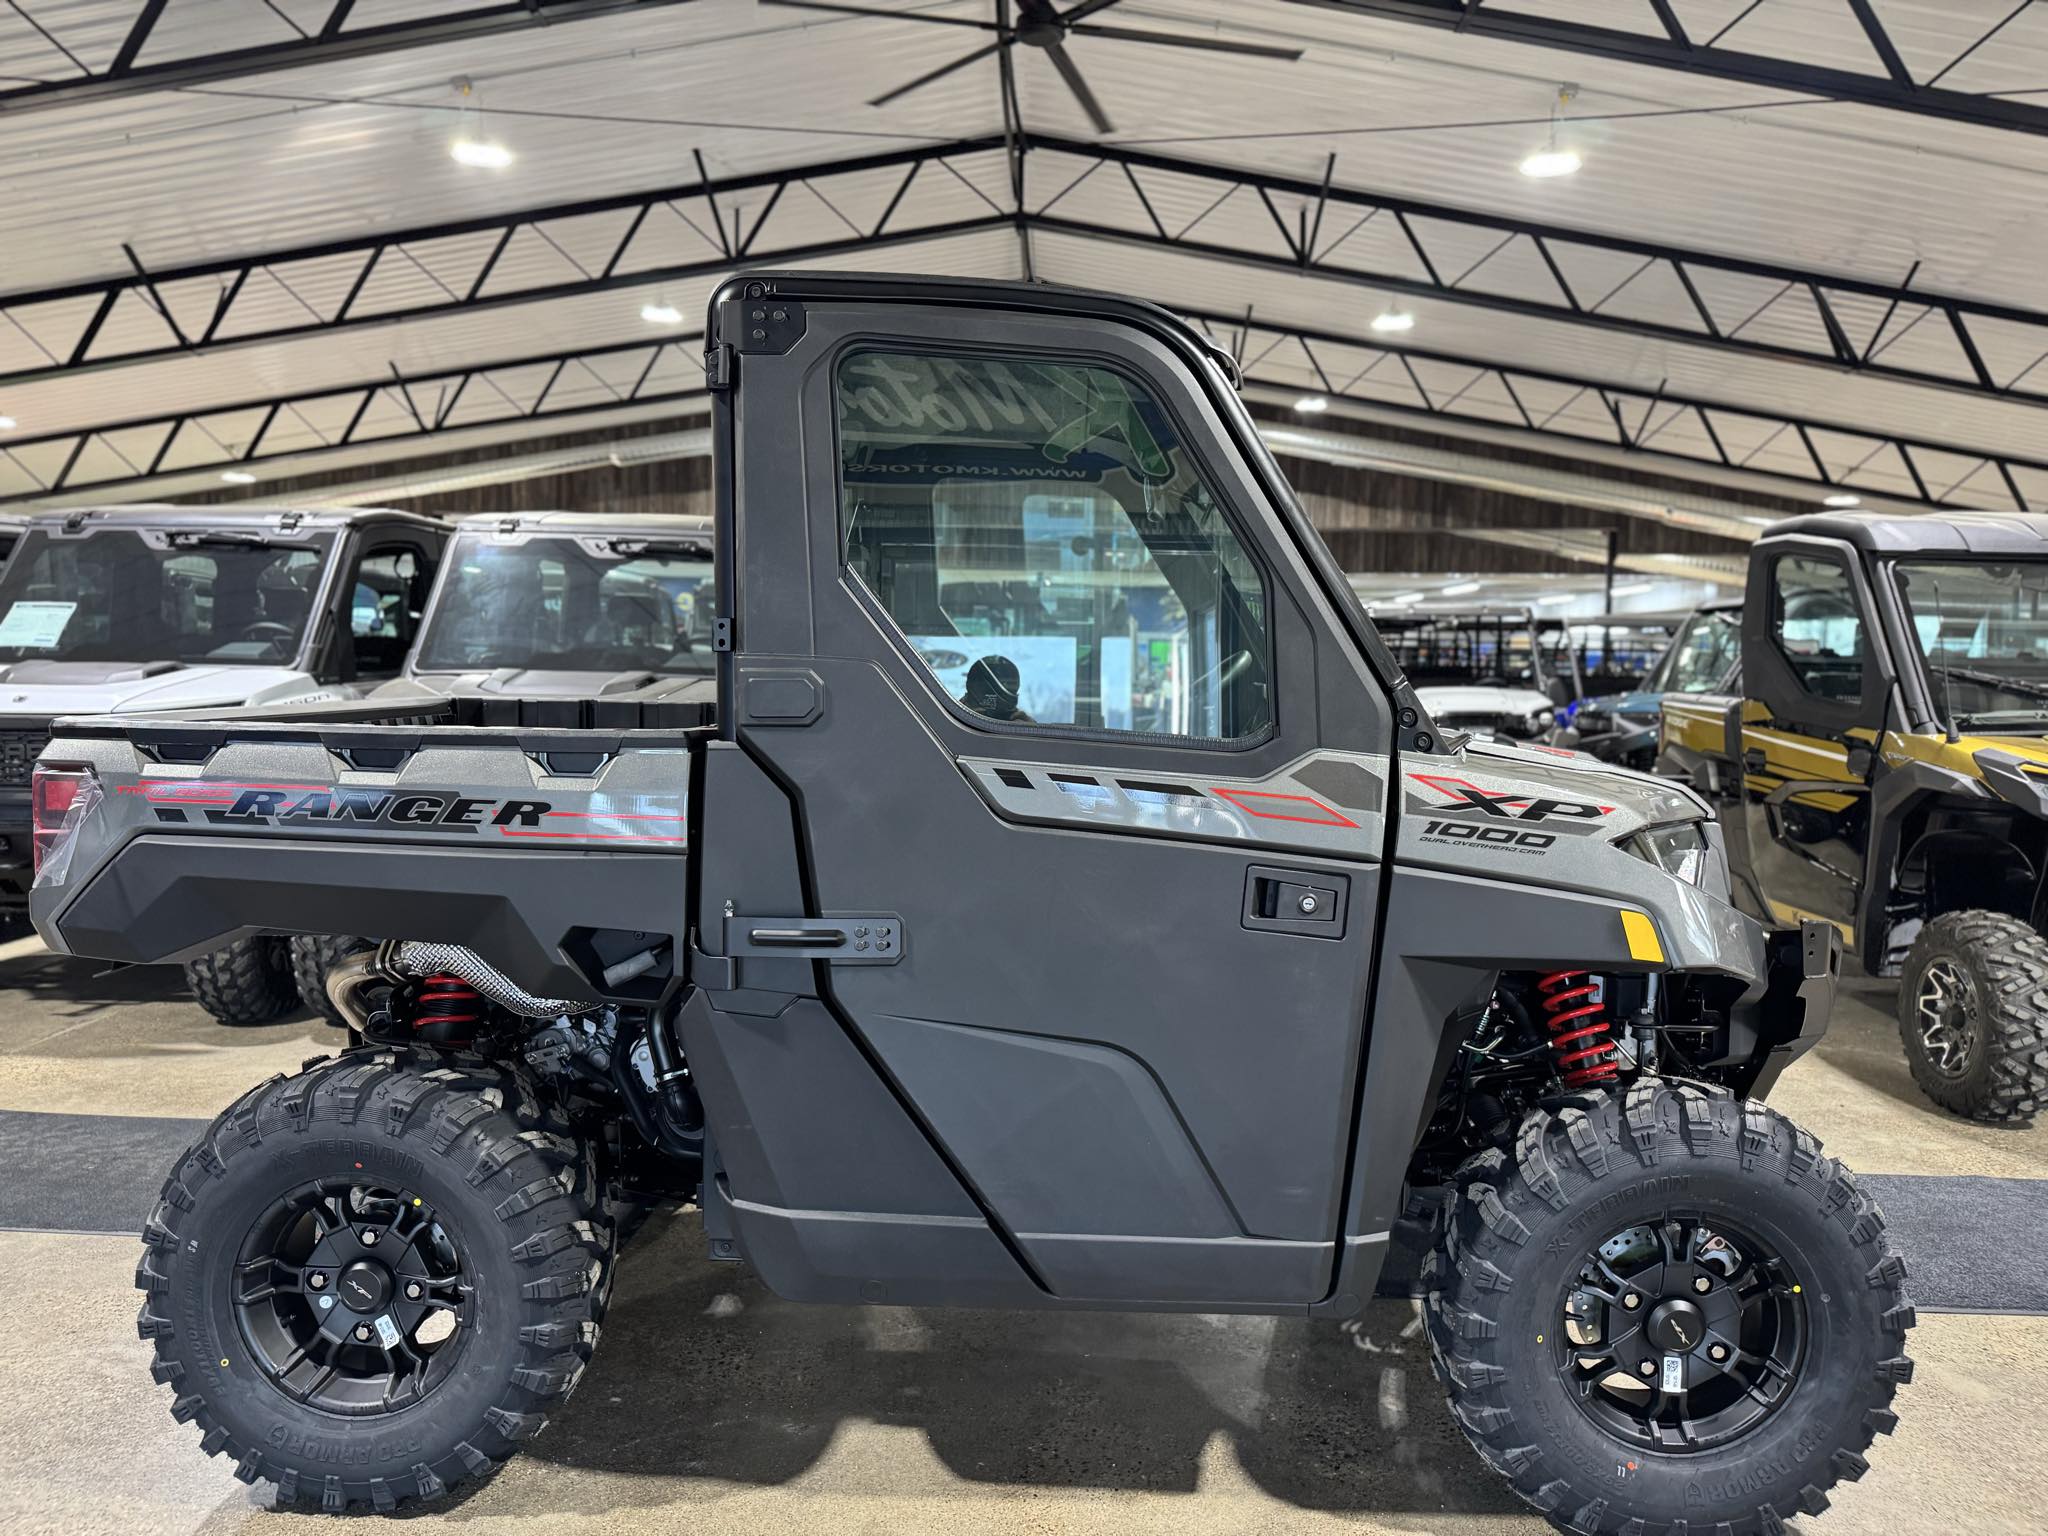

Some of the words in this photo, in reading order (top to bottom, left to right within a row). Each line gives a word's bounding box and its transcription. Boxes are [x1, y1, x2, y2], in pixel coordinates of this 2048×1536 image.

[223, 789, 552, 828] RANGER
[1430, 788, 1604, 822] XP
[1418, 835, 1450, 846] DUAL
[1453, 840, 1518, 853] OVERHEAD
[1519, 847, 1547, 857] CAM
[1422, 820, 1557, 849] 1000
